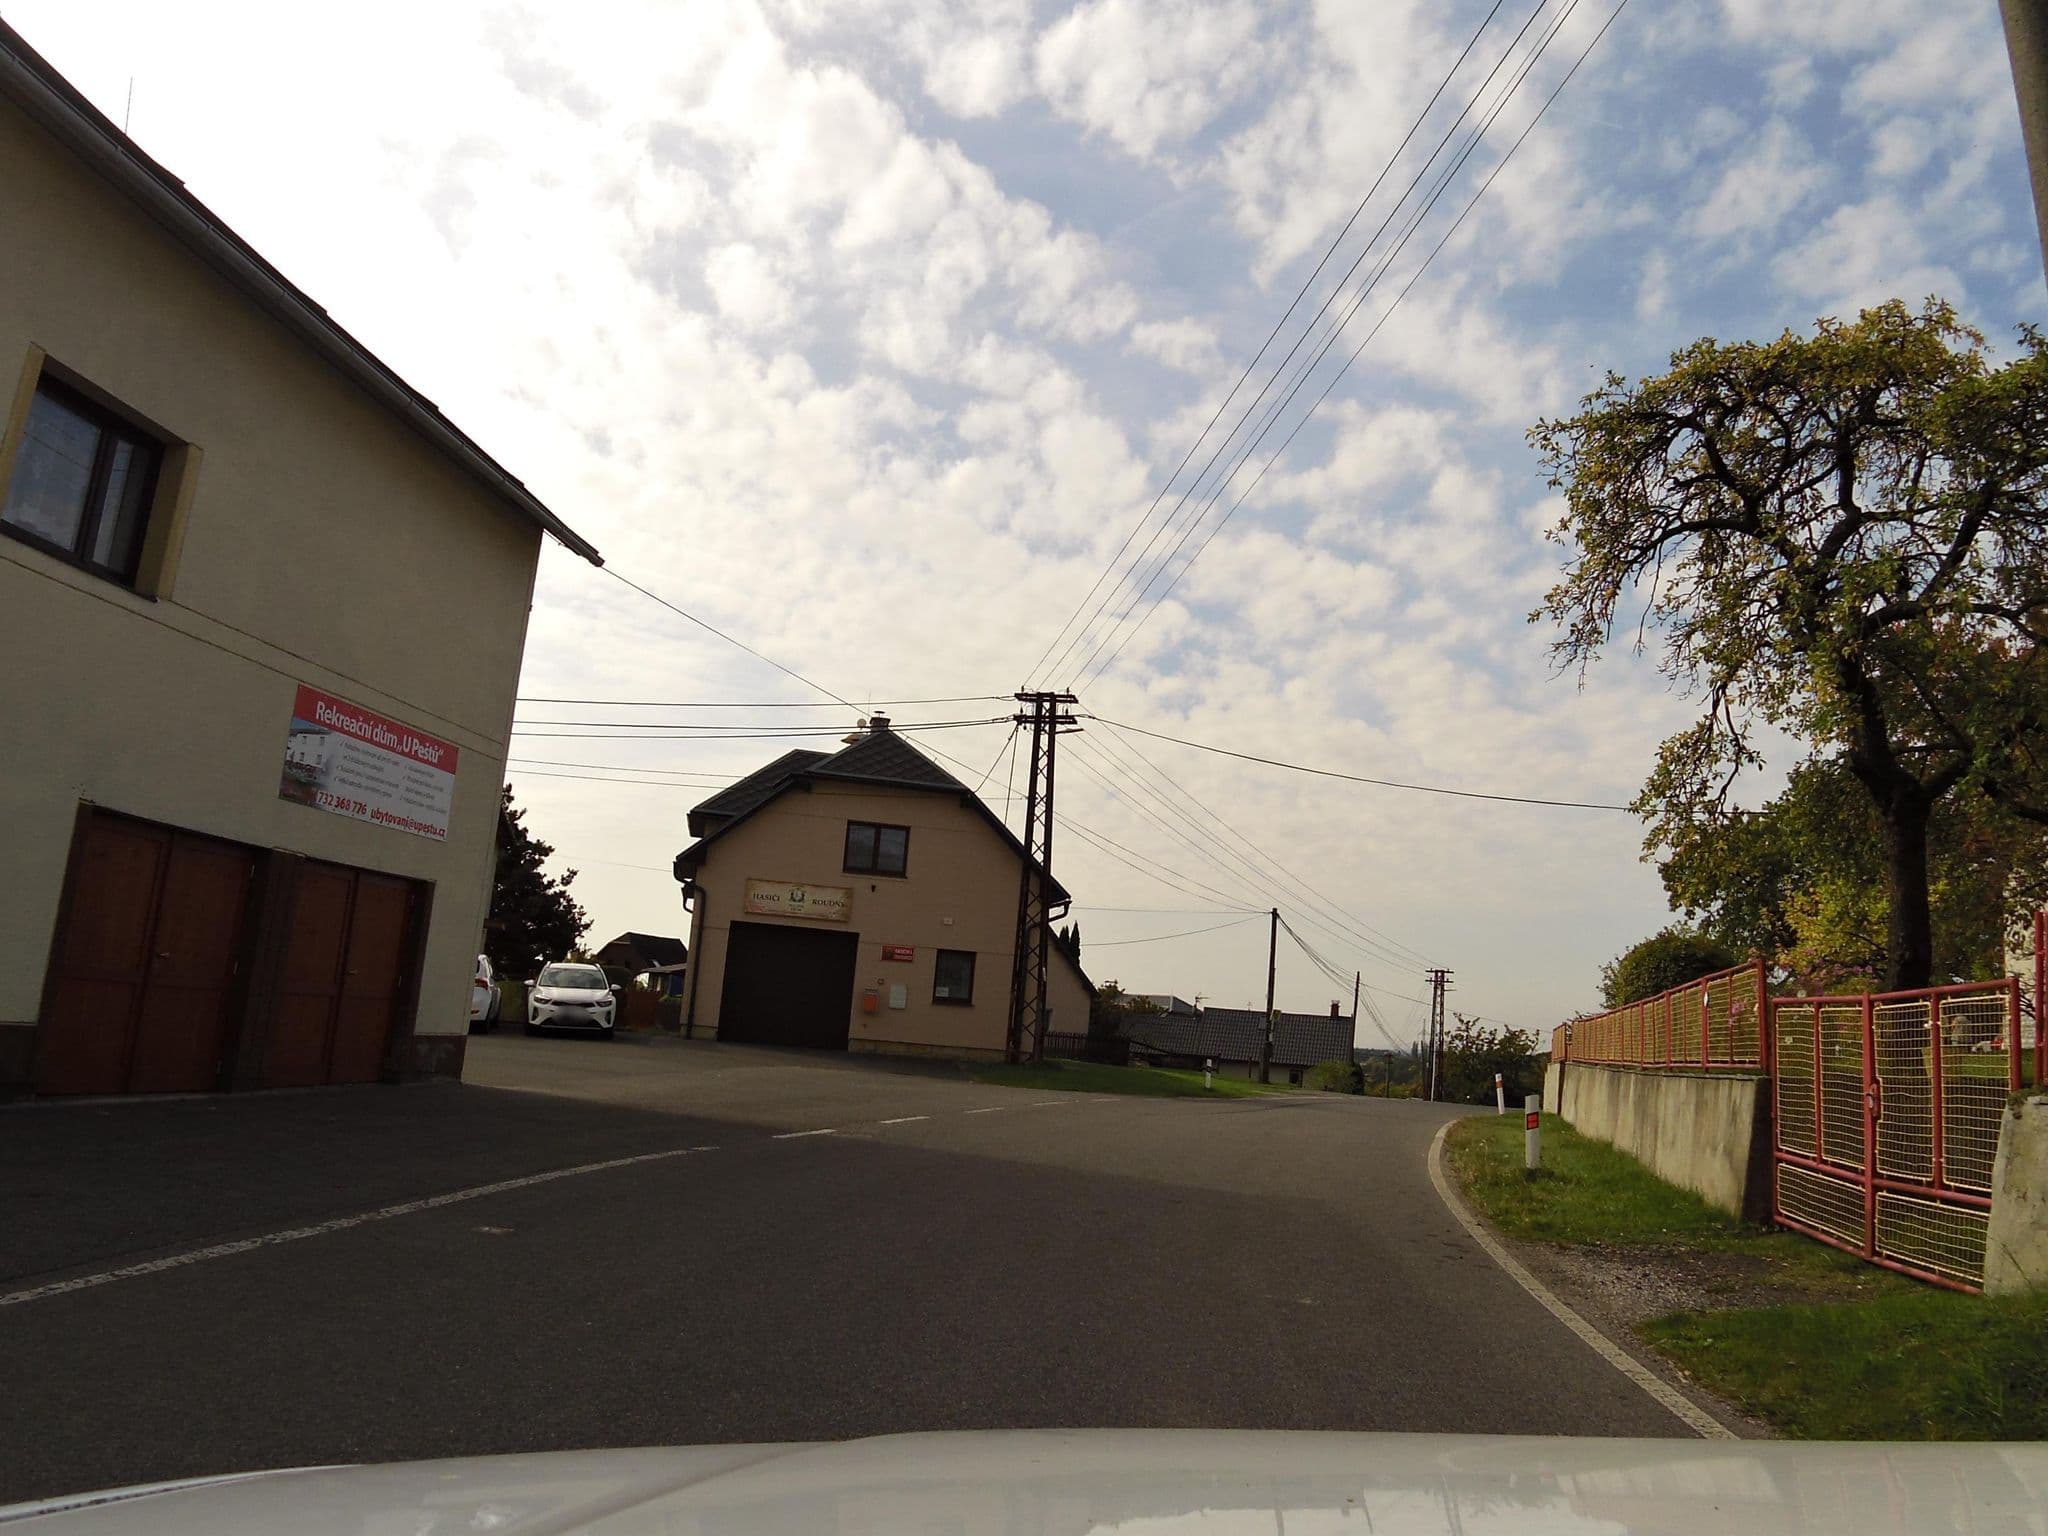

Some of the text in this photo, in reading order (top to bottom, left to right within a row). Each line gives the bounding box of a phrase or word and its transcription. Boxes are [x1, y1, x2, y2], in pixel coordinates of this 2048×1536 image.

[316, 701, 374, 739] Rekreační
[373, 724, 398, 749] dům
[318, 791, 334, 806] 732
[335, 796, 351, 810] 368
[352, 800, 367, 815] 776
